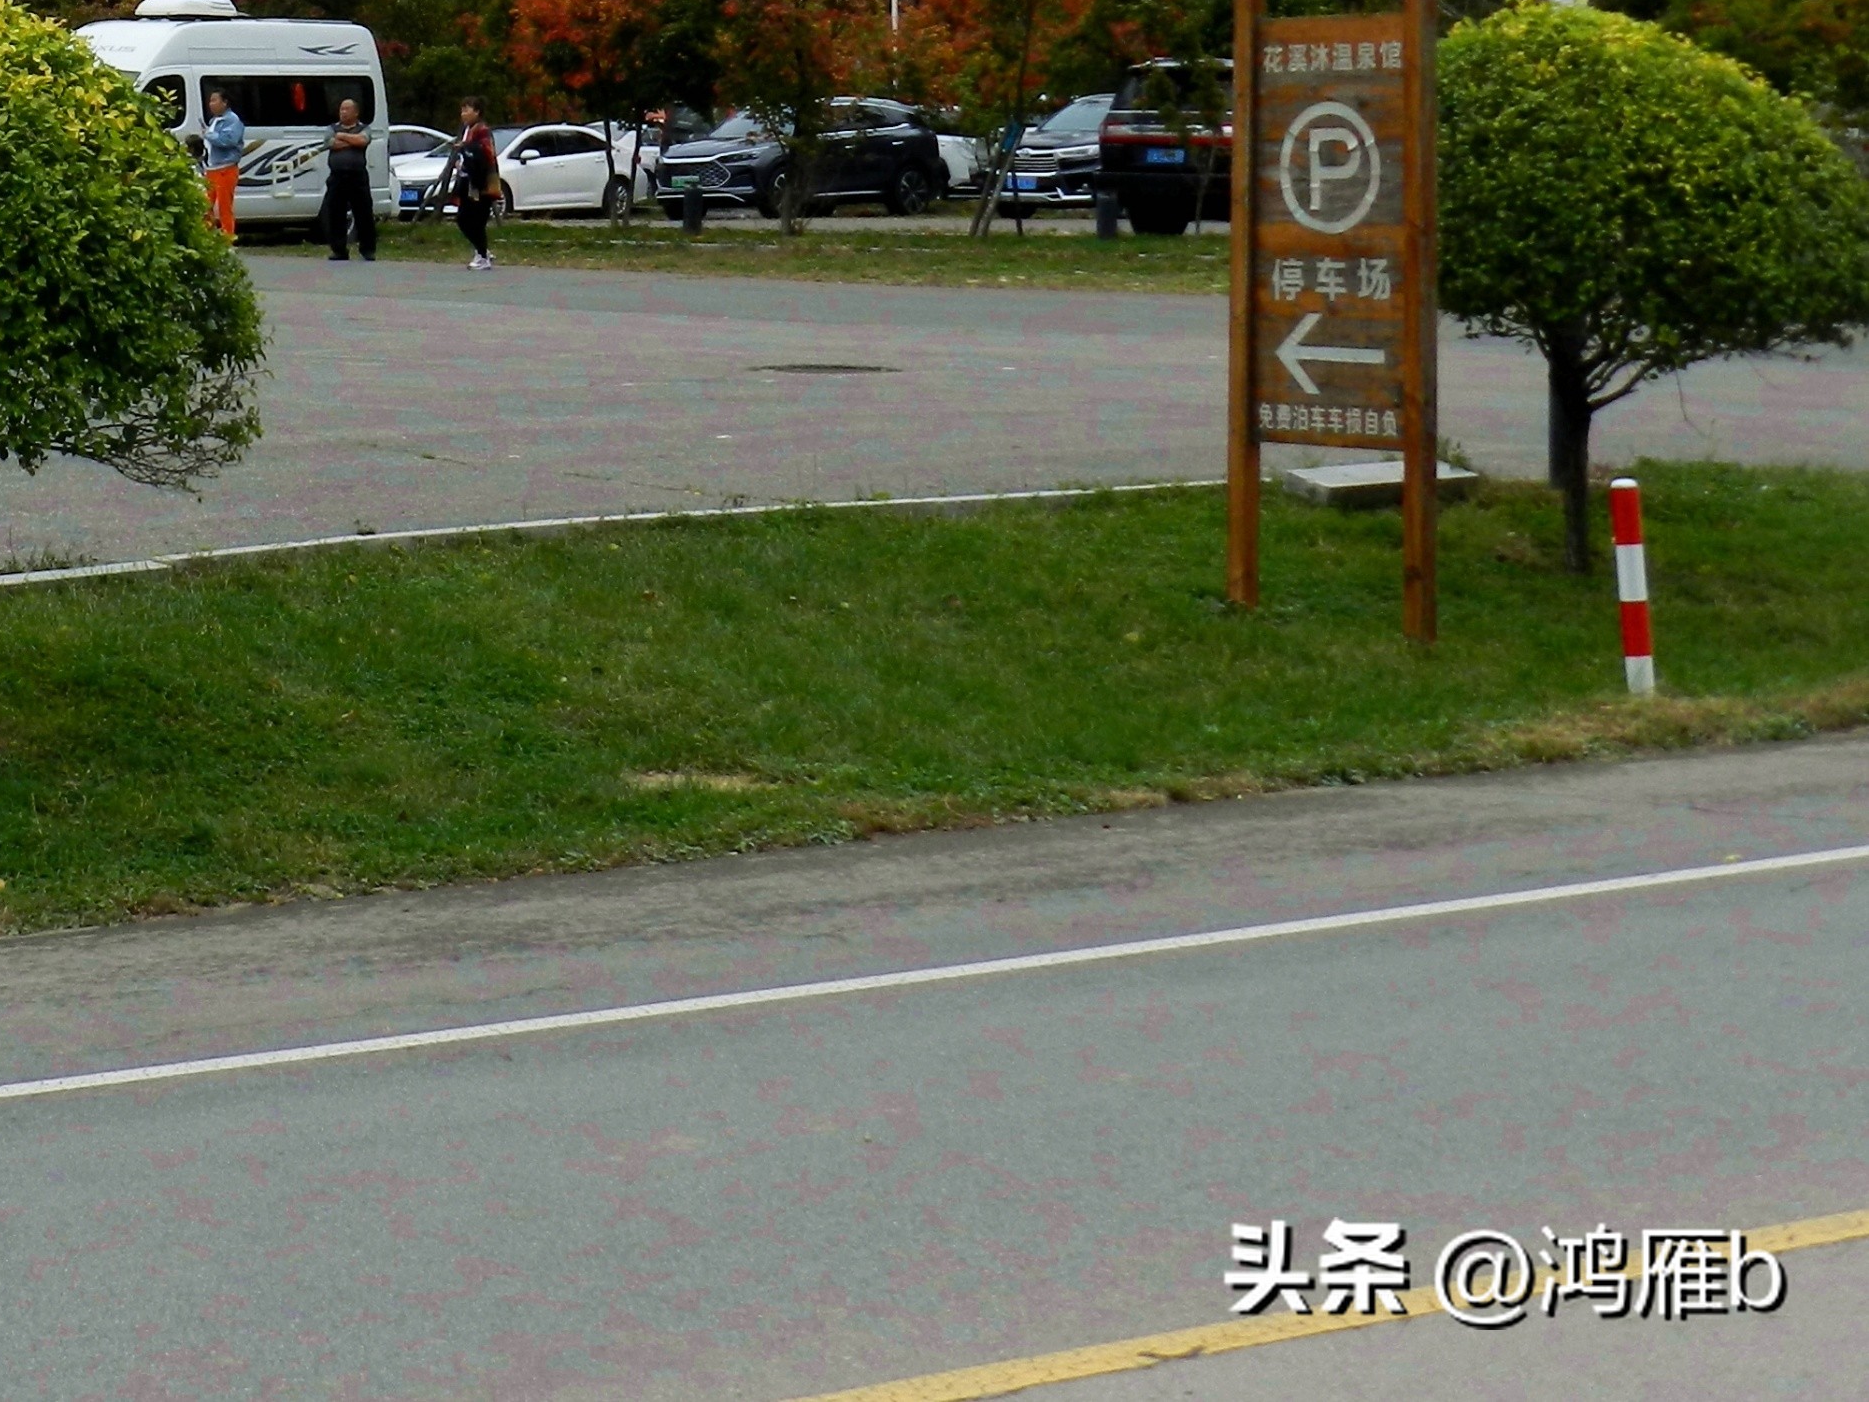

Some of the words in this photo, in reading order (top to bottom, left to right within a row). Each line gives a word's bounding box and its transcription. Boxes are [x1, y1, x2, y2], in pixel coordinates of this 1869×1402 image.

[1264, 41, 1402, 73] 花溪沐温泉馆
[1309, 127, 1361, 211] P
[1272, 257, 1391, 301] 停车场
[1259, 402, 1397, 437] 免费泊车车损自负
